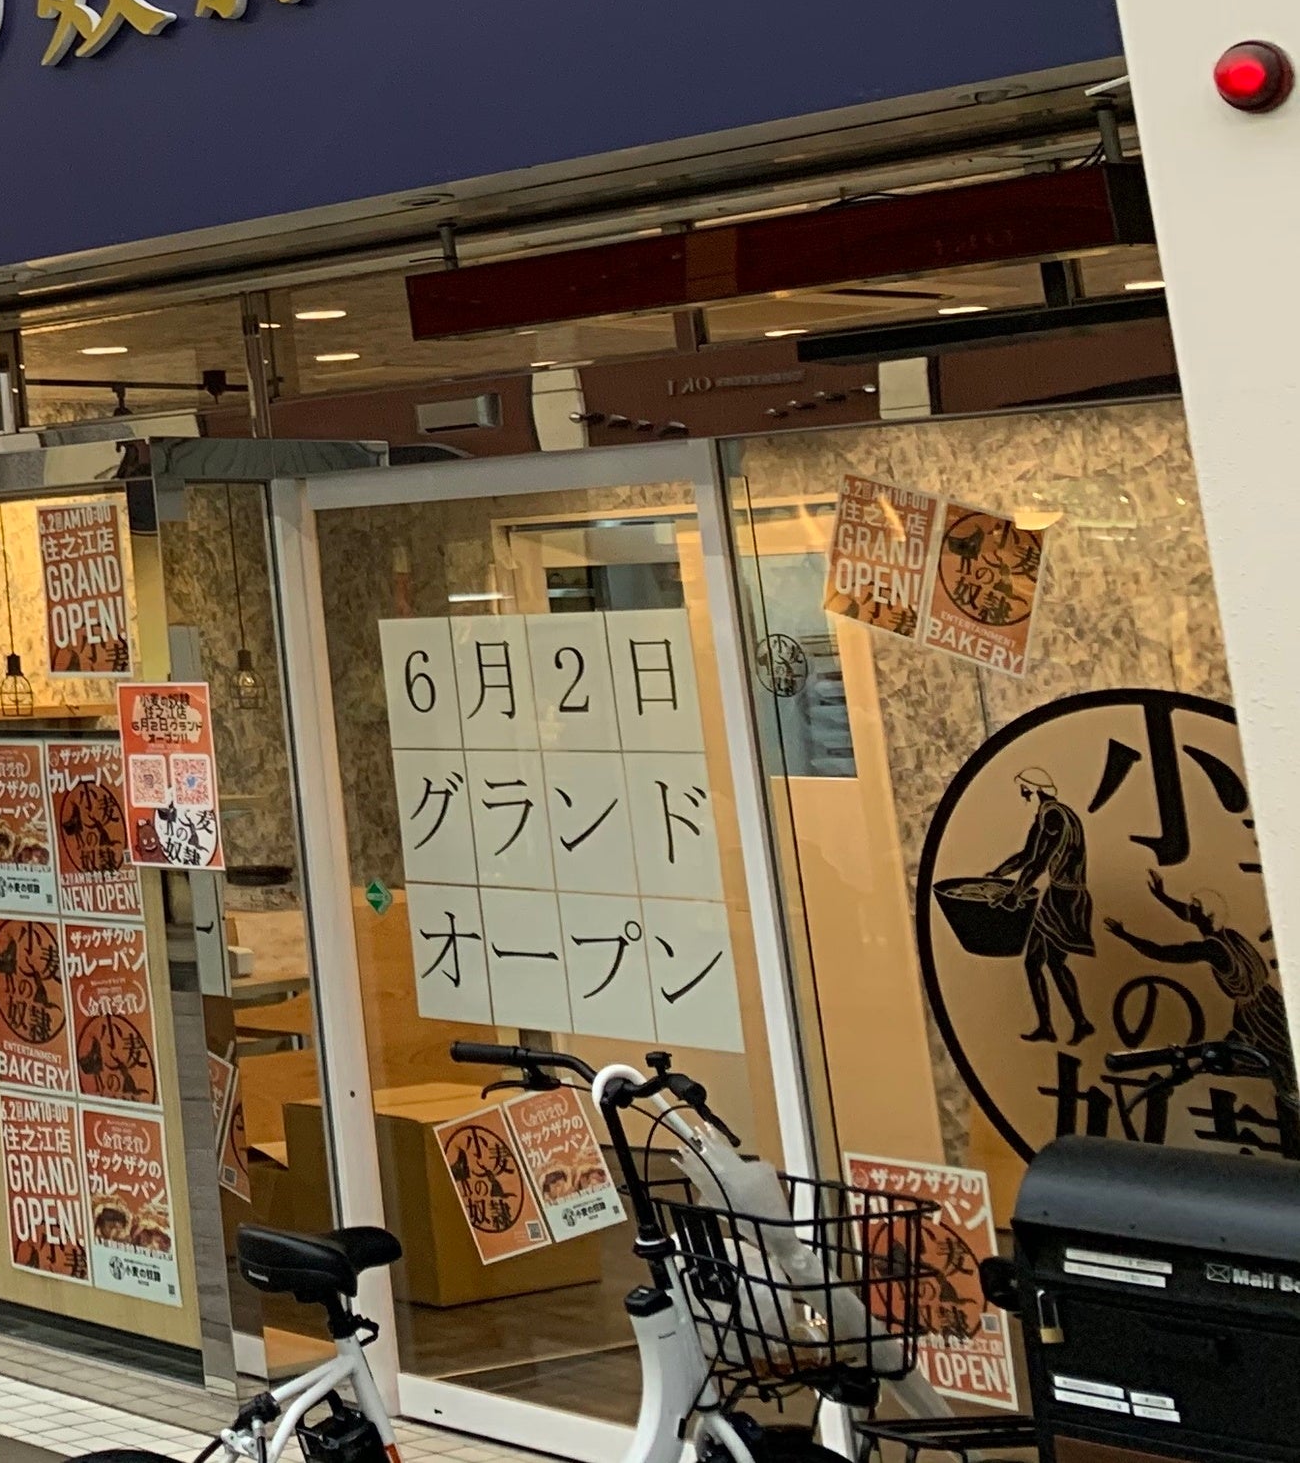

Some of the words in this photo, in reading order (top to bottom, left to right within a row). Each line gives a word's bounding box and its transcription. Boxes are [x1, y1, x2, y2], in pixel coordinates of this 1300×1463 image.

[41, 527, 116, 563] 住之江店
[837, 521, 926, 571] GRAND
[46, 554, 122, 603] GRAND
[834, 557, 923, 612] OPEN!
[51, 596, 128, 649] OPEN!
[928, 617, 1025, 675] BAKERY
[403, 637, 683, 721] 6月2日
[411, 770, 711, 866] グランド
[60, 885, 95, 912] NEW
[97, 882, 142, 912] OPEN!
[65, 947, 146, 979] カレーパン
[417, 910, 724, 1007] オープン
[3, 1123, 72, 1154] 住之江店
[7, 1153, 79, 1197] GRAND
[87, 1148, 162, 1180] ザックザクの
[88, 1171, 167, 1206] カレーパン
[12, 1196, 85, 1247] OPEN!
[1232, 1268, 1275, 1290] Mail
[934, 1346, 1012, 1394] OPEN!
